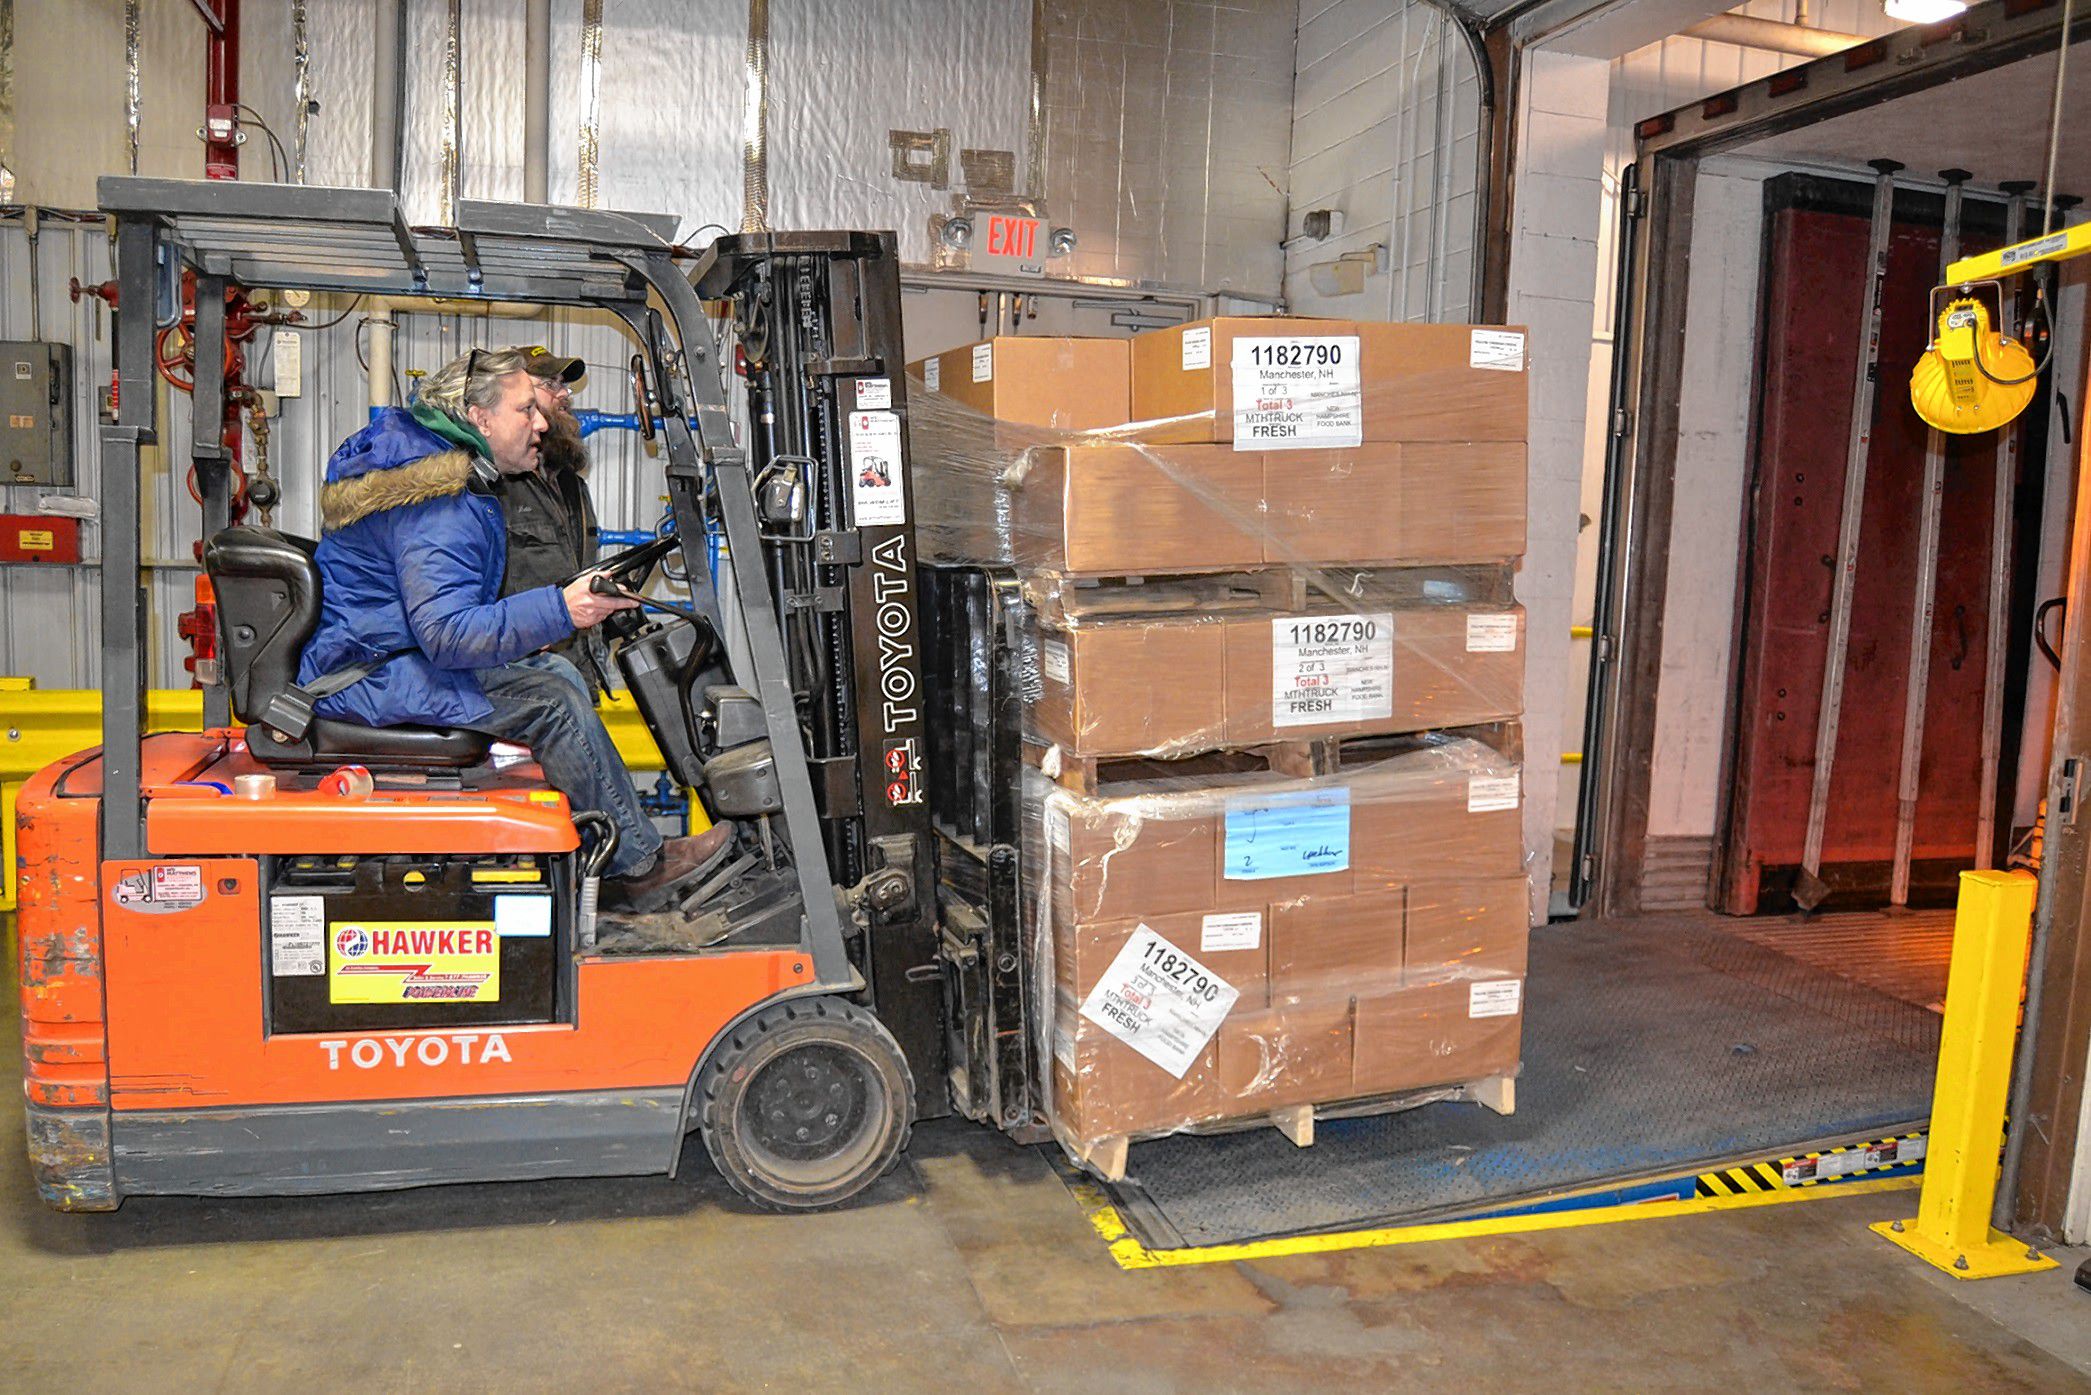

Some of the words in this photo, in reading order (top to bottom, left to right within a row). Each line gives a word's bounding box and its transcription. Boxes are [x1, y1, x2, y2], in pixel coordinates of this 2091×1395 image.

[987, 215, 1040, 259] EXIT
[1251, 344, 1341, 366] 1182790
[1259, 369, 1317, 380] Manchester,
[1318, 369, 1334, 379] NH
[1261, 386, 1266, 395] 1
[1268, 386, 1278, 395] of
[1282, 386, 1288, 395] 3
[1256, 399, 1283, 411] Total
[1286, 399, 1294, 410] 3
[1252, 425, 1297, 438] FRESH
[872, 534, 917, 733] TOYOTA
[1290, 621, 1376, 645] 1182790
[1298, 646, 1353, 657] Manchester,
[1354, 644, 1368, 654] NH
[1298, 663, 1304, 673] 2
[1306, 663, 1315, 672] of
[1319, 662, 1326, 671] 3
[1294, 675, 1320, 687] Total
[1322, 674, 1329, 685] 3
[1290, 700, 1332, 713] FRESH
[372, 930, 493, 955] HAWKER
[1143, 940, 1219, 1002] 1182790
[1120, 982, 1145, 1005] Total
[1143, 997, 1153, 1010] 3
[1187, 994, 1201, 1009] NH
[1101, 1002, 1141, 1034] FRESH
[319, 1034, 513, 1071] TOYOTA
